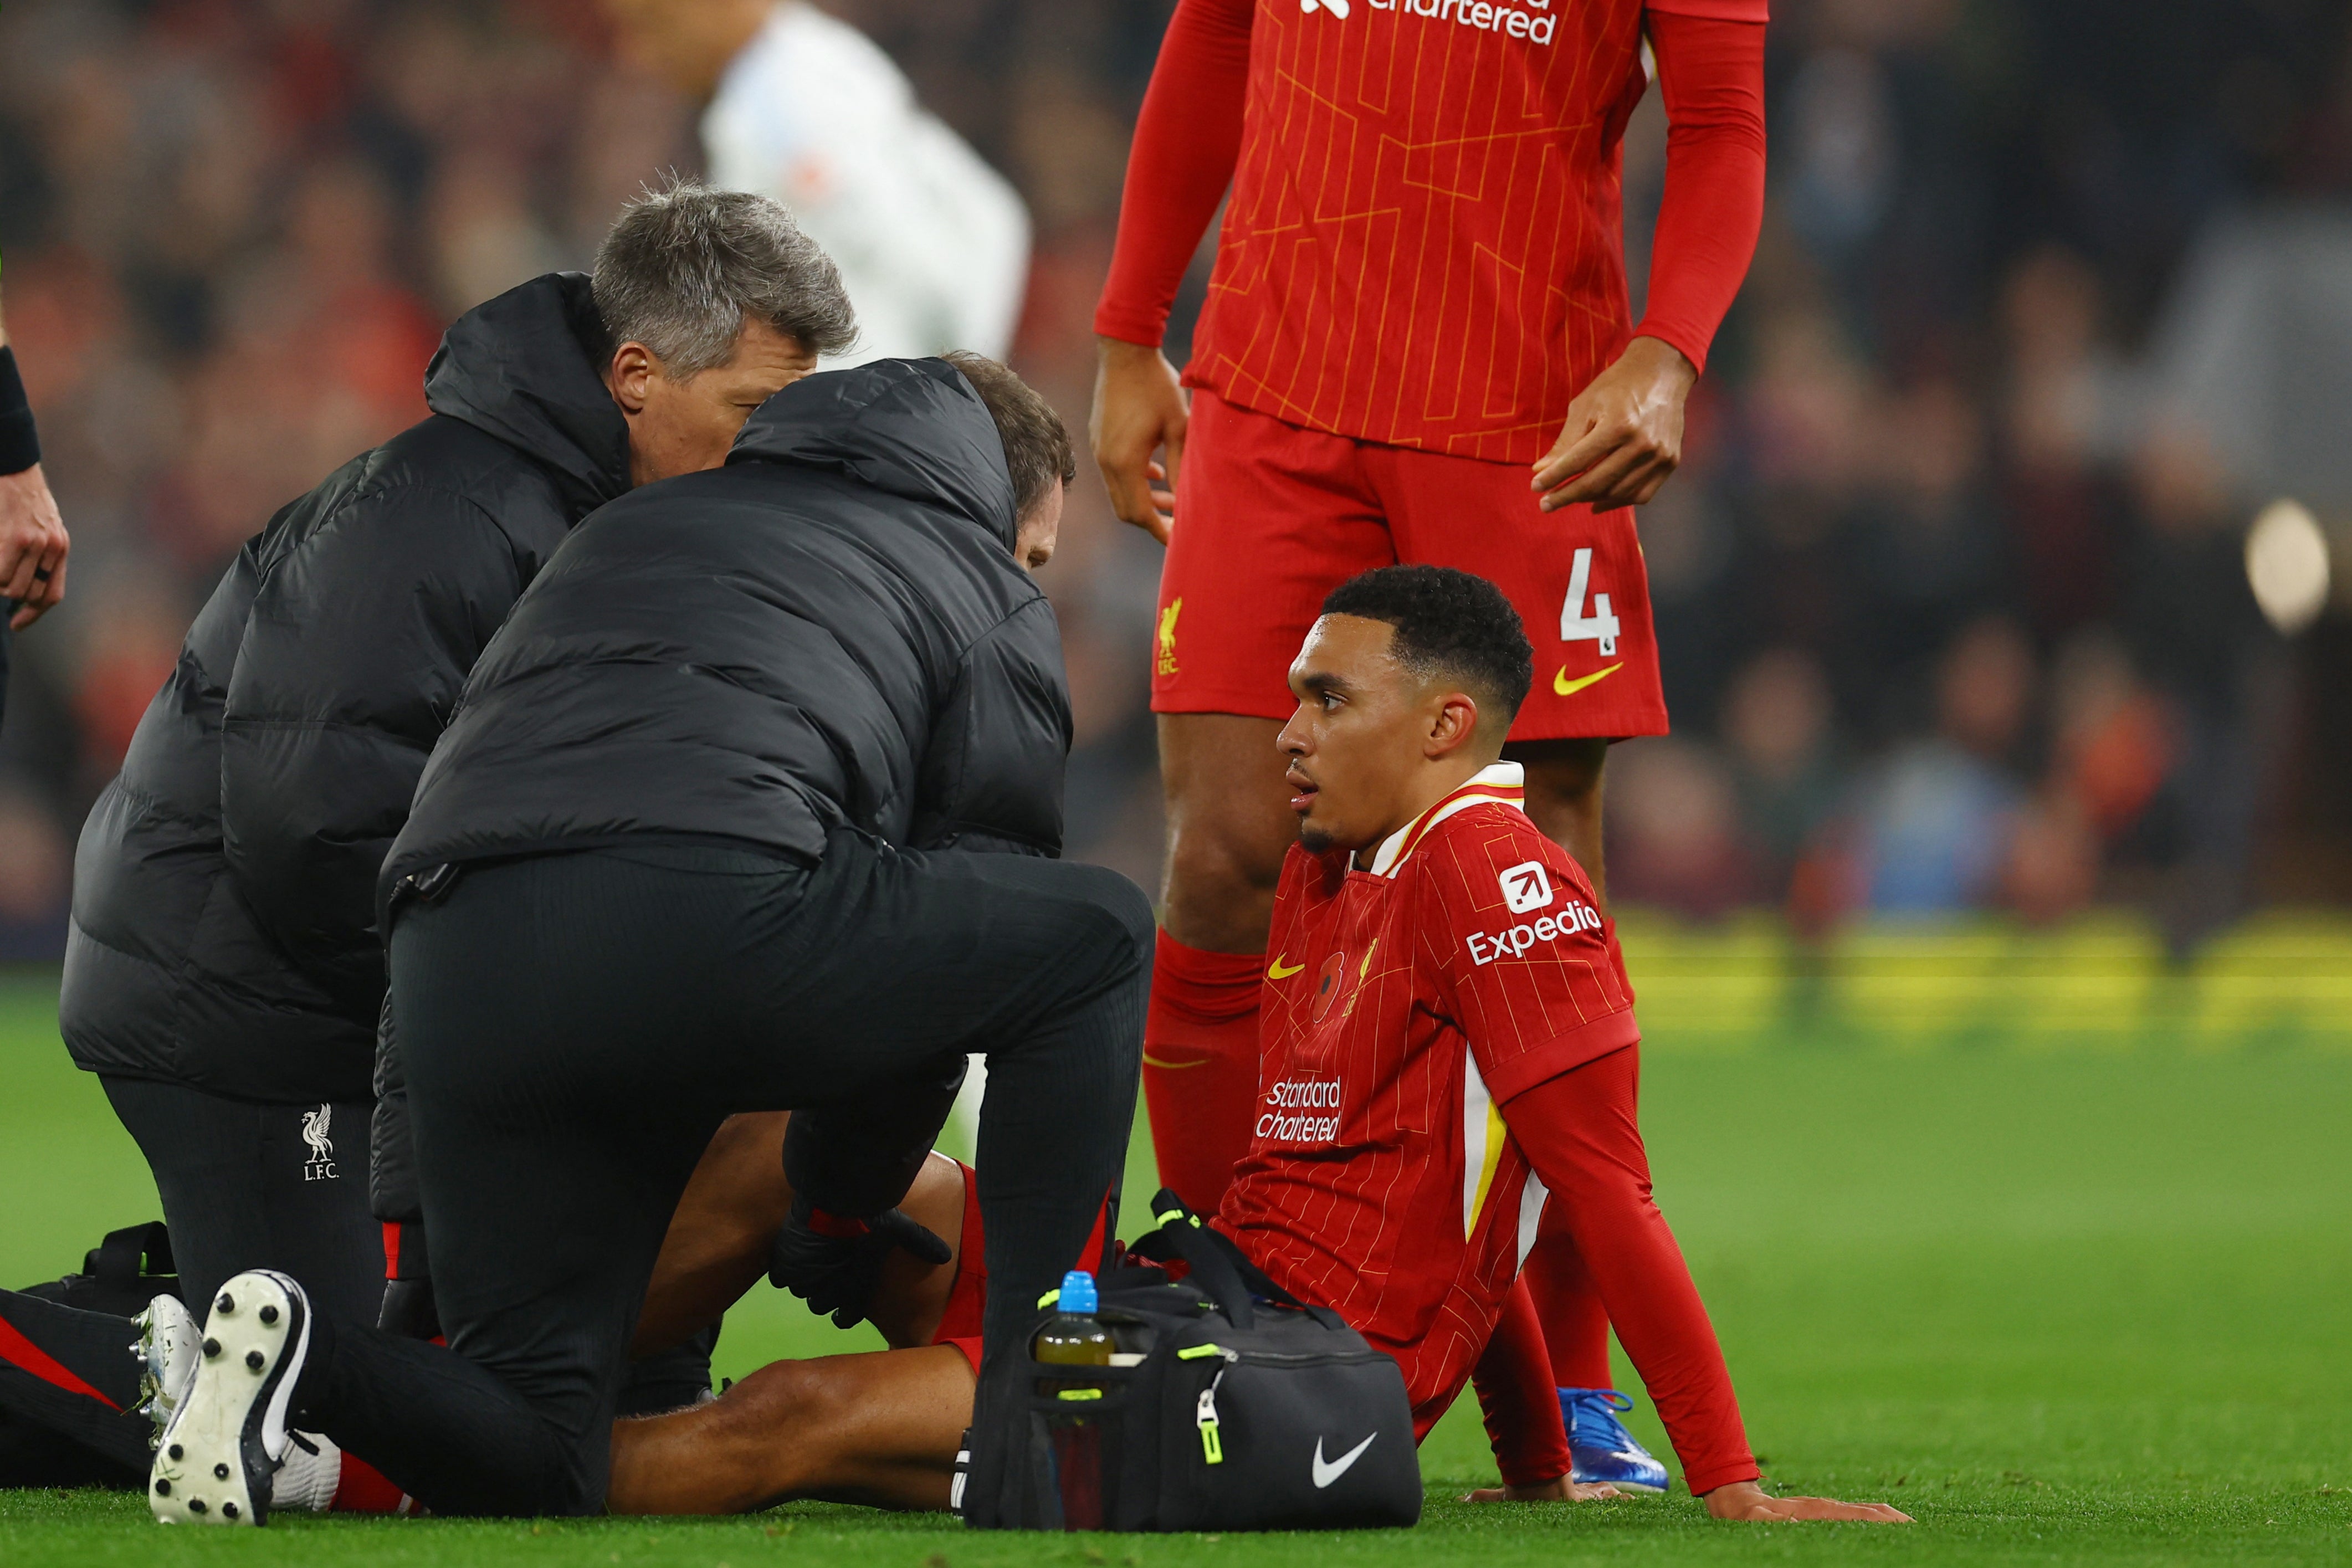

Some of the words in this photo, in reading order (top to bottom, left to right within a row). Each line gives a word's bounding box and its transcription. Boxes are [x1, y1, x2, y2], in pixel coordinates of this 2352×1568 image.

[1560, 547, 1621, 657] 4
[1466, 900, 1602, 966] Expedia
[1266, 1075, 1340, 1108] standard
[1256, 1109, 1341, 1142] chartered
[304, 1163, 340, 1181] L.F.C.
